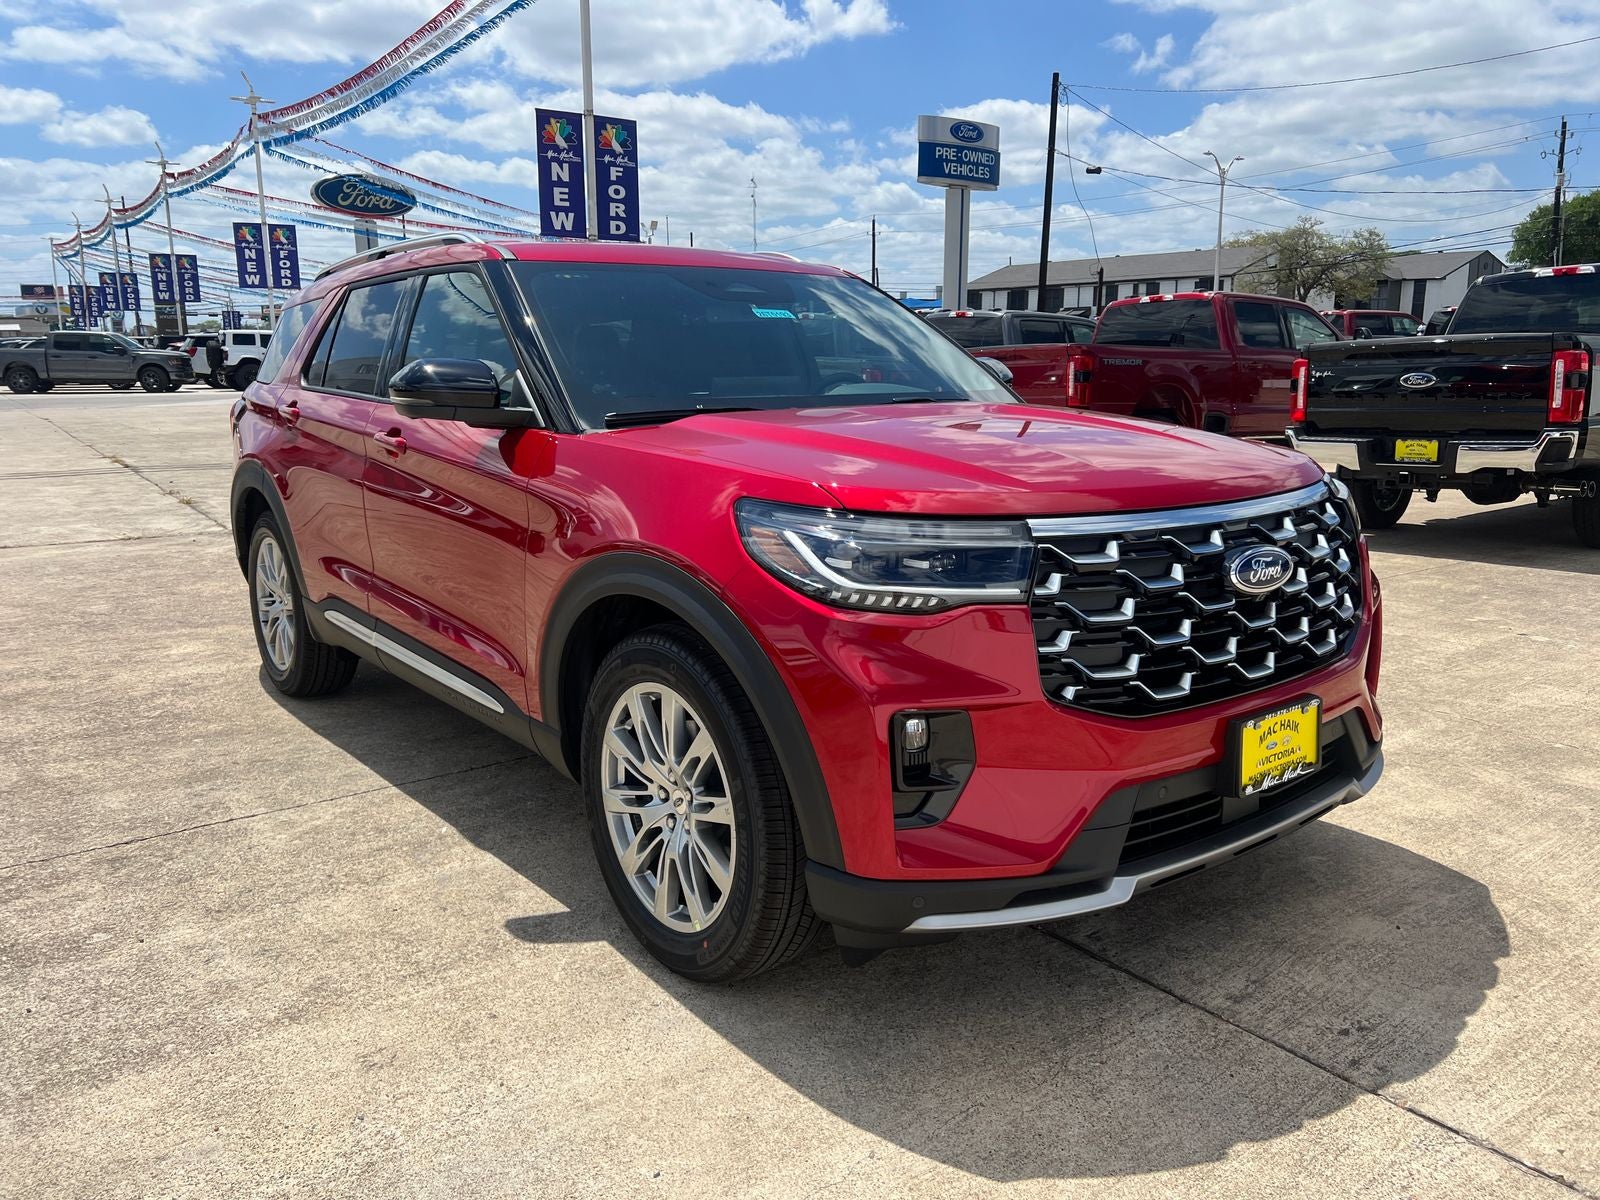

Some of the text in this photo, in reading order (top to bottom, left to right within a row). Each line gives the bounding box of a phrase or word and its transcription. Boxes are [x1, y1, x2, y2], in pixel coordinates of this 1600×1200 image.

[958, 124, 978, 138] Ford
[943, 162, 990, 179] VEHICLES
[549, 162, 575, 231] NEW
[607, 166, 627, 235] FORD
[244, 248, 260, 285] NEW
[279, 250, 292, 286] FORD
[105, 287, 116, 309] NEW
[157, 272, 169, 300] NEW
[183, 273, 194, 300] FORD
[73, 298, 82, 315] NEW
[127, 288, 136, 309] FORD
[1102, 358, 1143, 366] TREMOR
[1407, 375, 1427, 385] Ford
[1250, 556, 1282, 583] Ford
[1259, 721, 1278, 747] MAC
[1279, 719, 1300, 734] HAIK
[1260, 747, 1295, 766] VICTORIA
